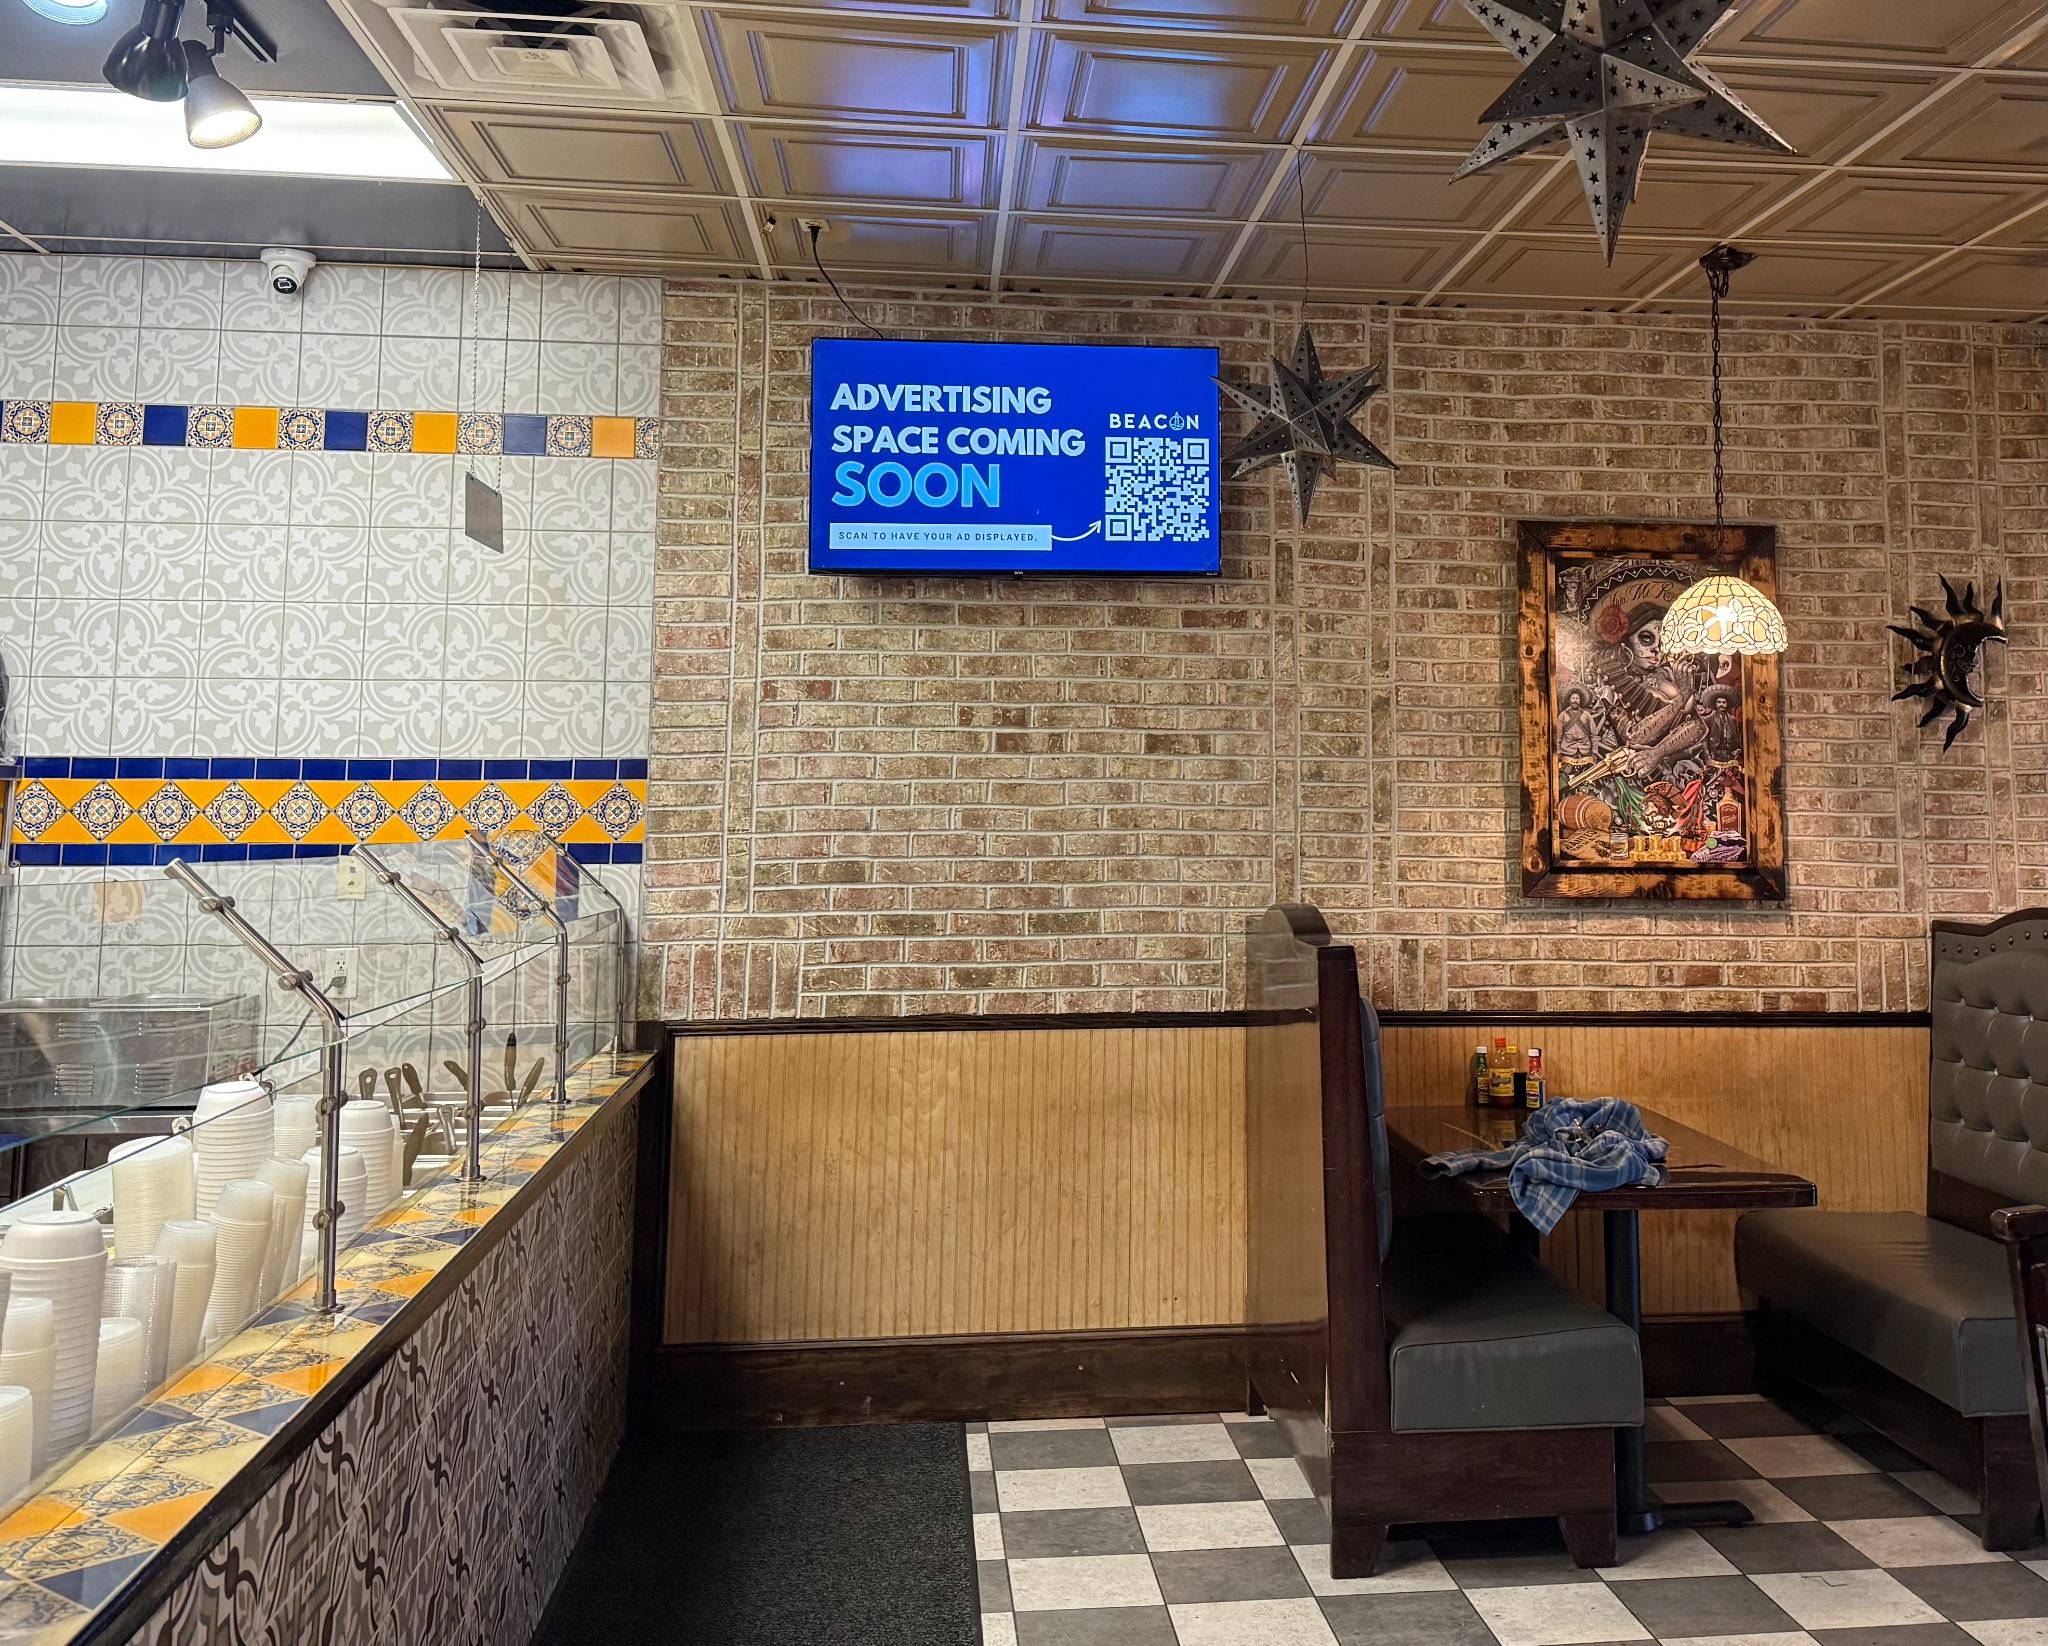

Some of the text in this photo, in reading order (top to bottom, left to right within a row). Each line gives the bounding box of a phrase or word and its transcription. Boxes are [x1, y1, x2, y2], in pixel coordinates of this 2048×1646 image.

[830, 382, 1052, 414] ADVERTISING
[1109, 412, 1199, 430] BEACON
[831, 425, 1086, 457] SPACE COMING
[831, 460, 1000, 508] SOON
[838, 531, 1038, 542] SCAN TO HAVE YOUR AD DISPLAYED.
